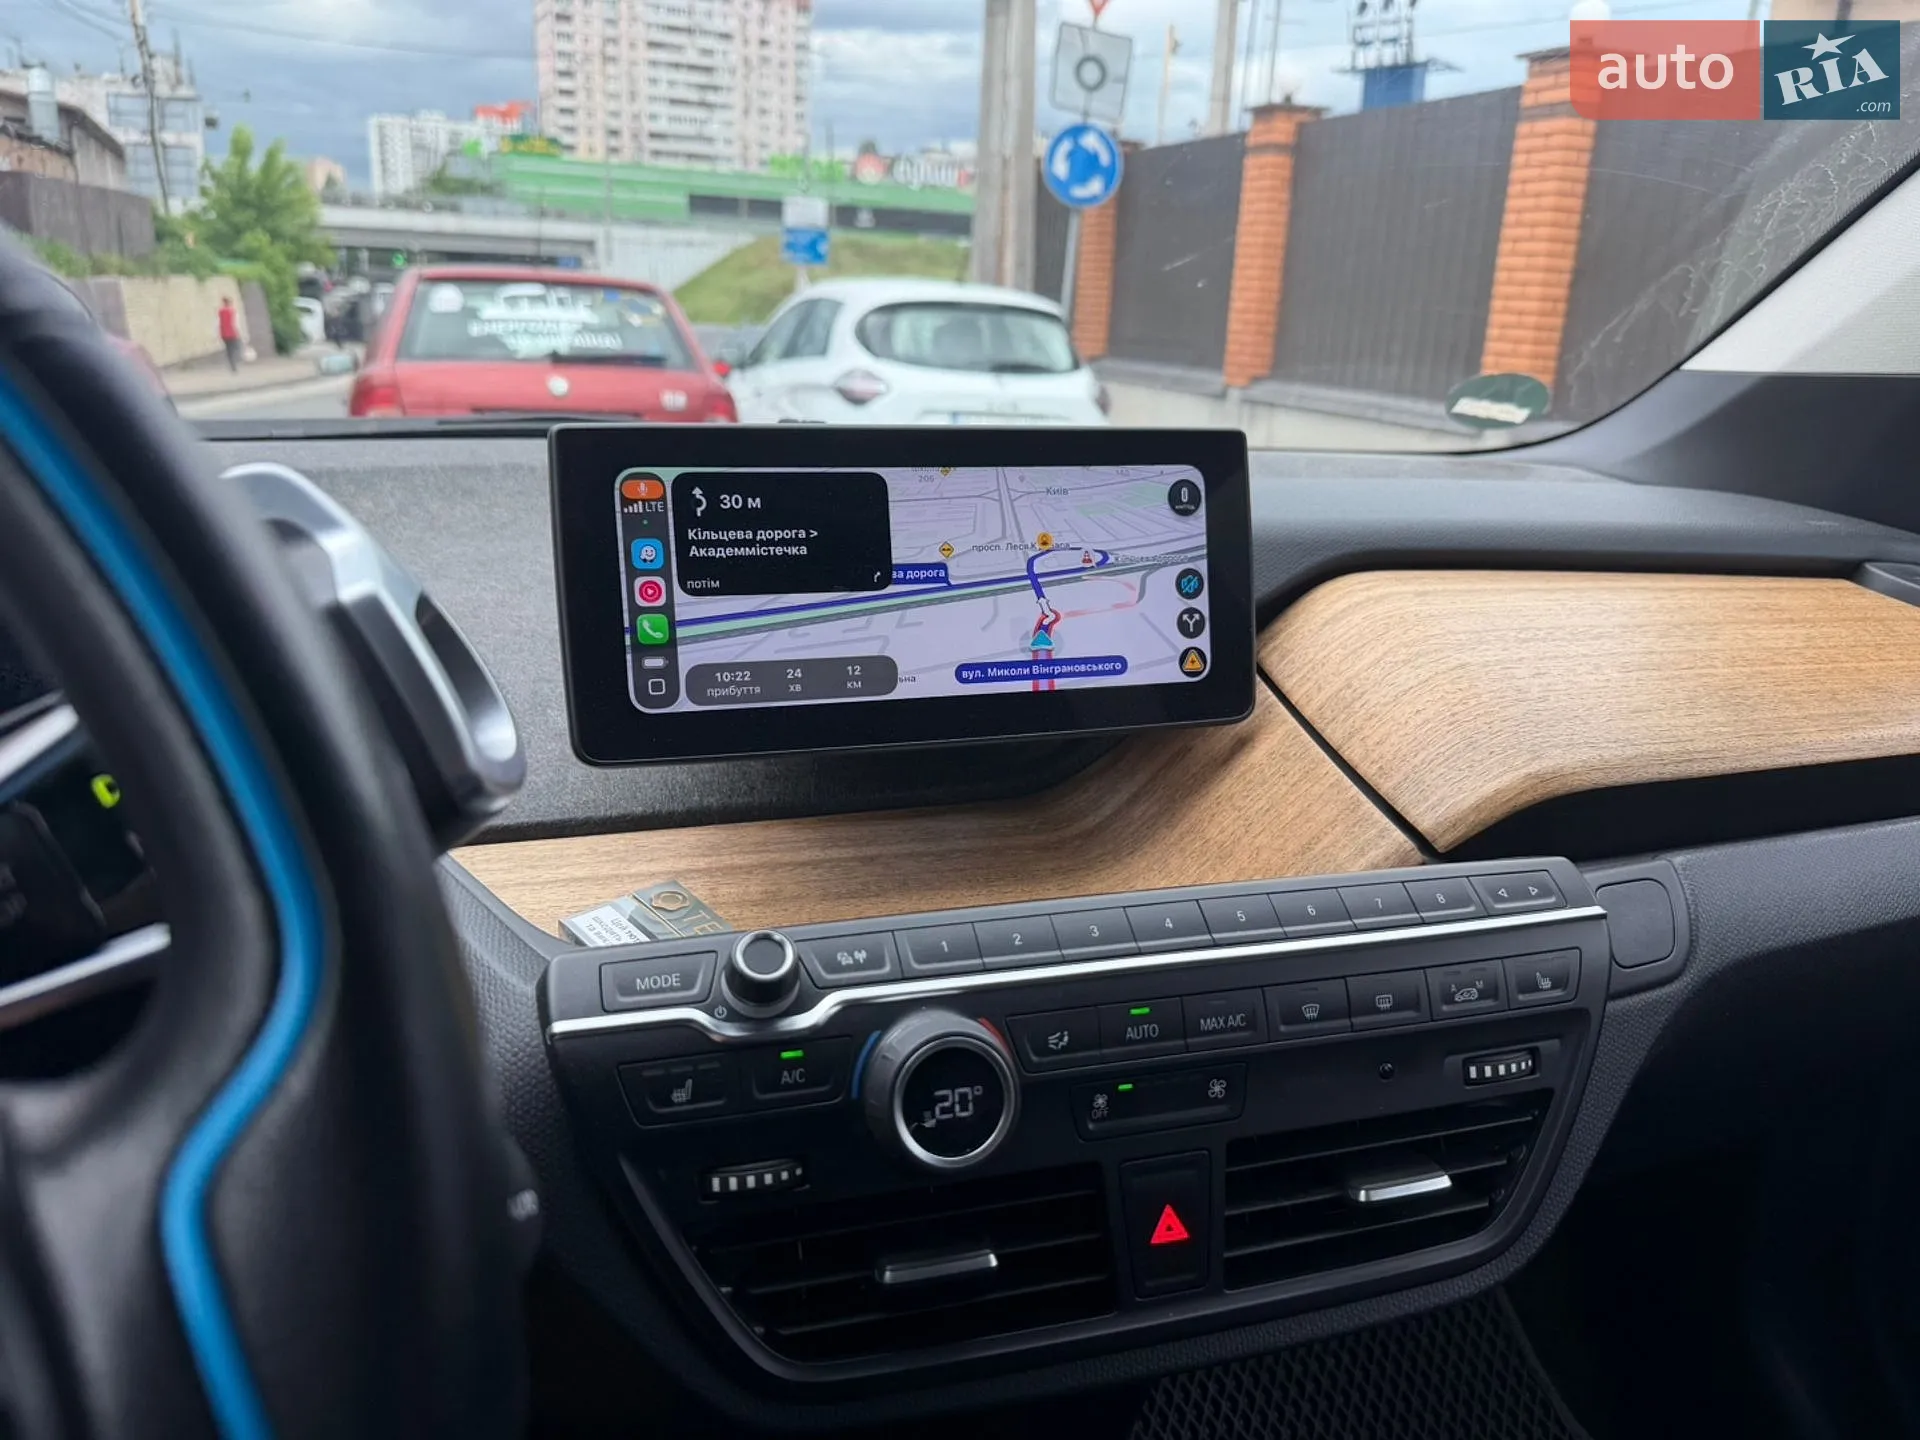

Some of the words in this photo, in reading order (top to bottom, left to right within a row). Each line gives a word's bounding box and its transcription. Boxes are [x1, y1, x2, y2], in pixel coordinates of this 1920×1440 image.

[645, 501, 665, 512] LTE
[719, 494, 743, 509] 30
[747, 496, 762, 509] м
[688, 528, 753, 541] Кільцева
[756, 528, 807, 542] дорога
[688, 544, 808, 558] Академмістечка
[905, 569, 946, 580] дорога
[686, 578, 720, 589] потім
[715, 671, 751, 682] 10:22
[786, 669, 802, 679] 24
[847, 665, 862, 676] 12
[962, 670, 984, 680] вул.
[988, 667, 1030, 678] Миколи
[1032, 661, 1122, 675] Вінграновського
[789, 683, 802, 692] хв
[847, 680, 862, 689] км
[707, 685, 761, 698] прибуття
[1374, 897, 1384, 910] 7
[1436, 892, 1446, 905] 8
[1236, 910, 1246, 922] 5
[1307, 904, 1316, 917] 6
[1164, 917, 1173, 930] 4
[1089, 924, 1099, 938] 3
[1013, 932, 1023, 945] 2
[940, 940, 948, 953] 1
[635, 973, 681, 989] MODE
[1200, 1015, 1226, 1031] MAX
[1226, 1011, 1247, 1027] A/C
[1125, 1023, 1159, 1041] AUTO
[781, 1068, 806, 1085] A/C
